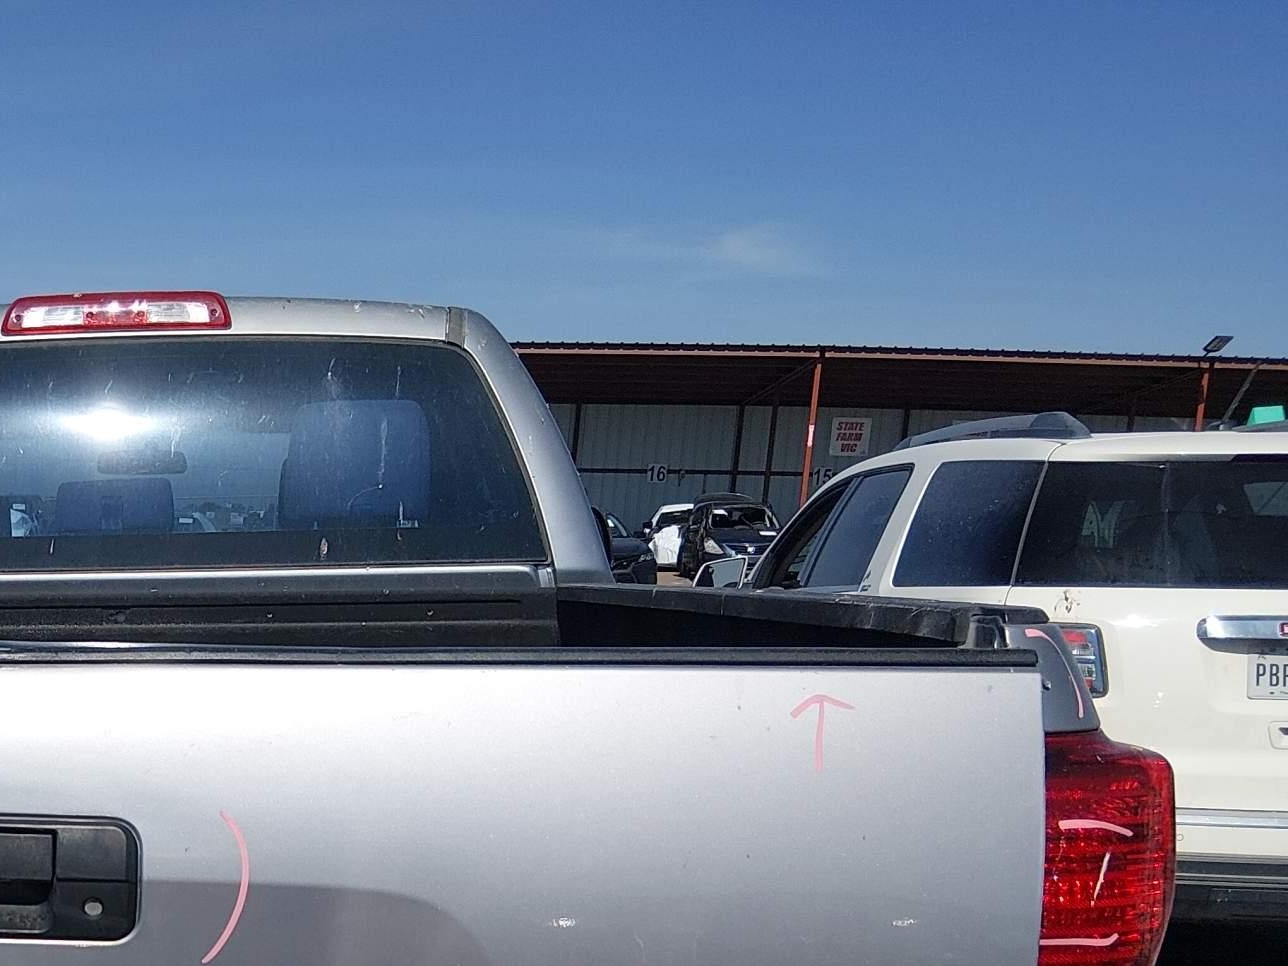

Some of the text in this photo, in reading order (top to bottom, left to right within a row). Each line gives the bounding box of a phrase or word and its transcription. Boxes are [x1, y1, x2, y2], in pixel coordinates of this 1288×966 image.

[836, 422, 865, 431] STATE
[836, 433, 863, 441] FARM
[648, 465, 666, 481] 16
[814, 468, 832, 486] 15
